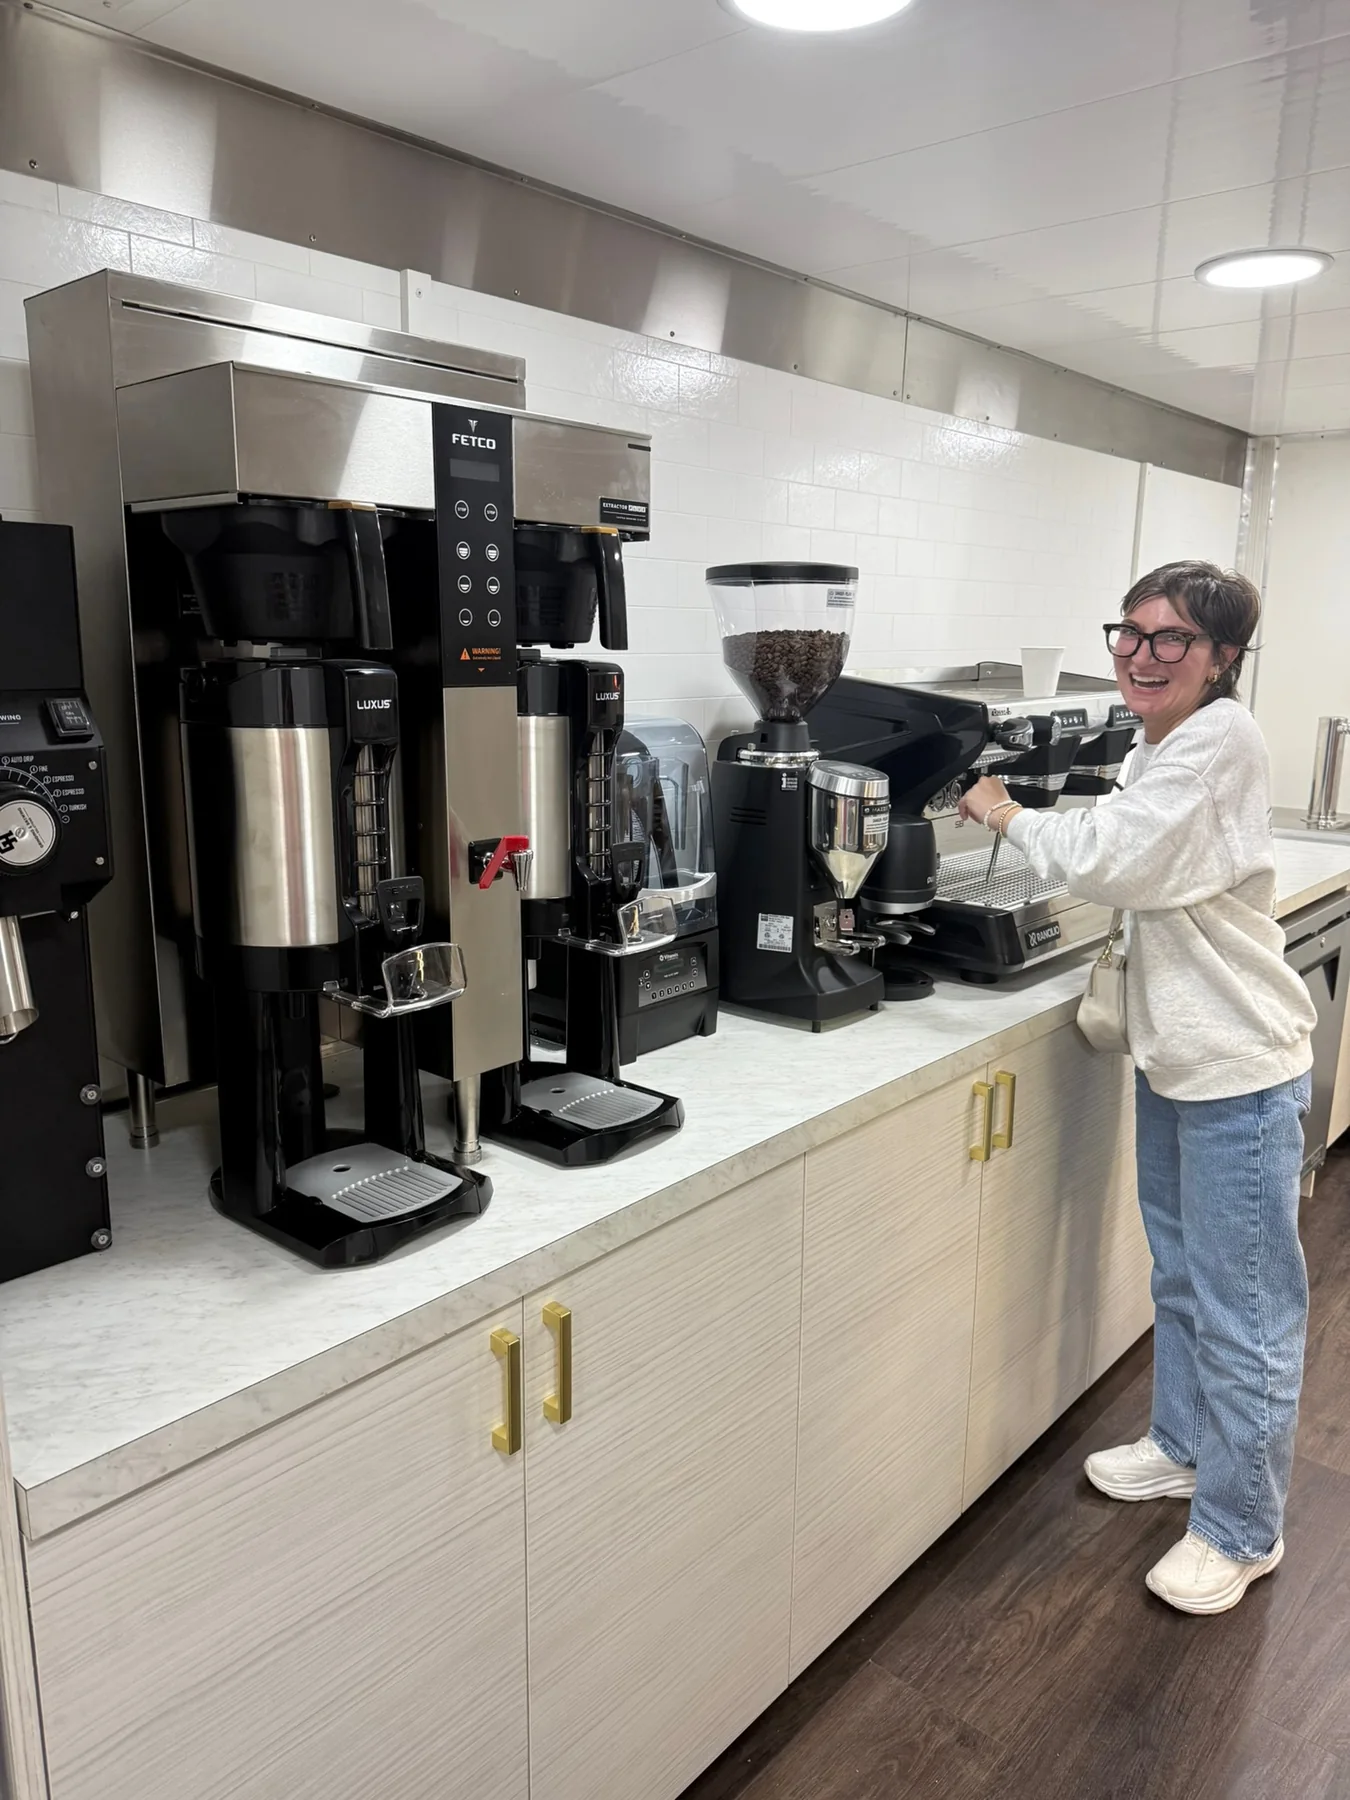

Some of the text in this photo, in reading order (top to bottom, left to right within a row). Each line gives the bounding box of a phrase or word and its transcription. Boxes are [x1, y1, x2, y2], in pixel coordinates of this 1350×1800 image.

[452, 433, 496, 450] FETCO
[602, 502, 628, 510] EXTRACTOR
[472, 647, 501, 655] WARNING!
[595, 692, 620, 701] LUXUS
[356, 699, 391, 710] LUXUS
[11, 755, 22, 763] AUTO
[52, 774, 75, 782] ESPRESSO
[62, 788, 84, 796] ESPRESSO
[69, 803, 87, 811] TURKISH
